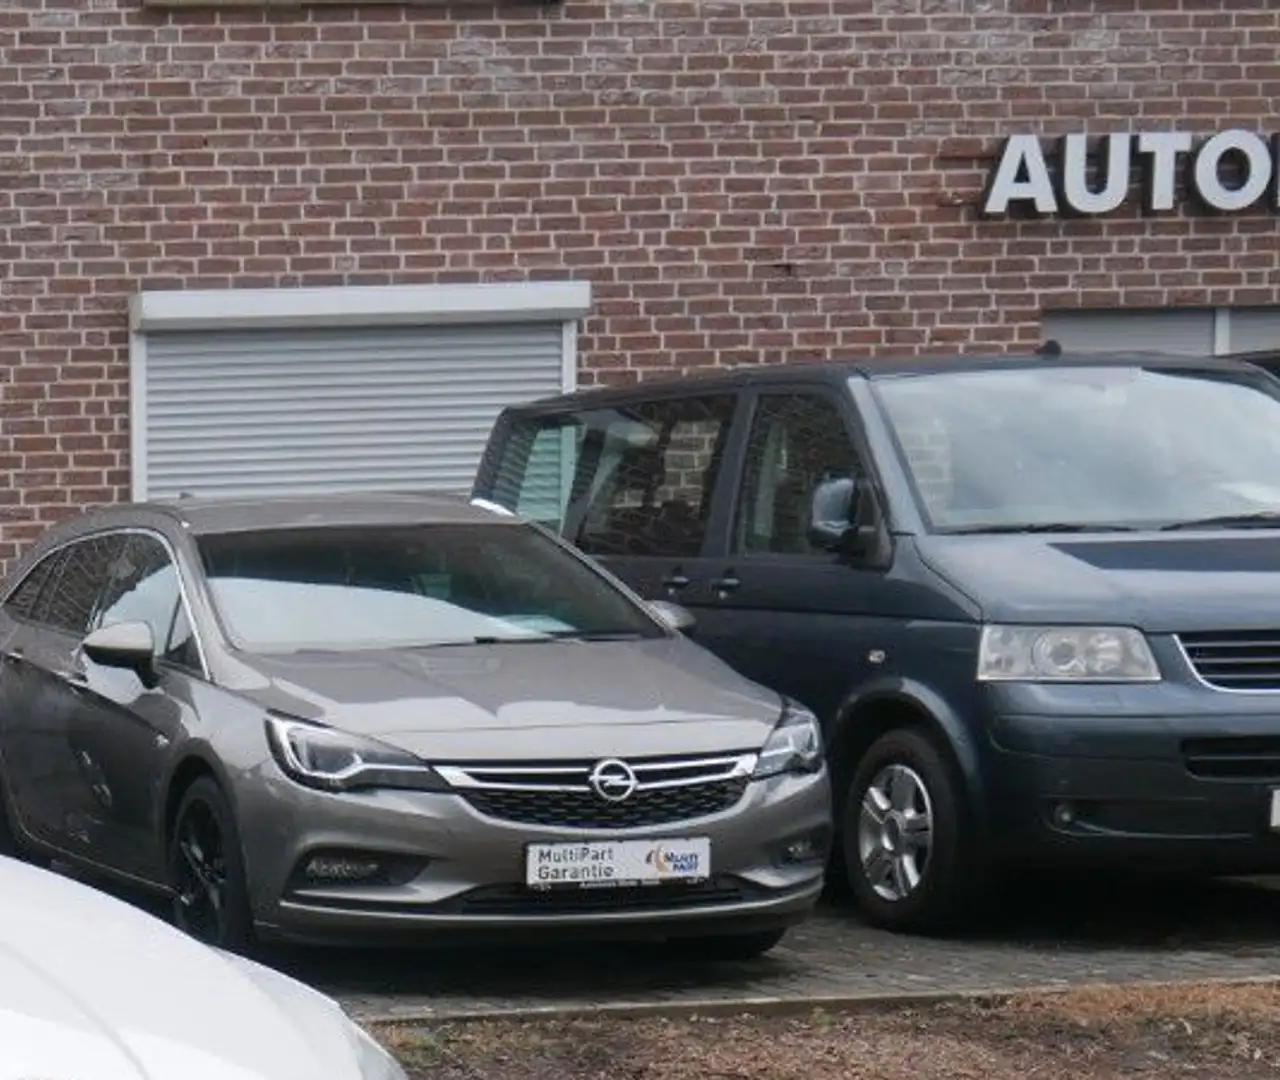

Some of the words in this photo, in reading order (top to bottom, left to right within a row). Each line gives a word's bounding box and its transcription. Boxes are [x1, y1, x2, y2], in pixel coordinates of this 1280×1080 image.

[984, 129, 1280, 213] AUTO
[538, 847, 614, 863] MultiPart
[538, 862, 614, 880] Garantie
